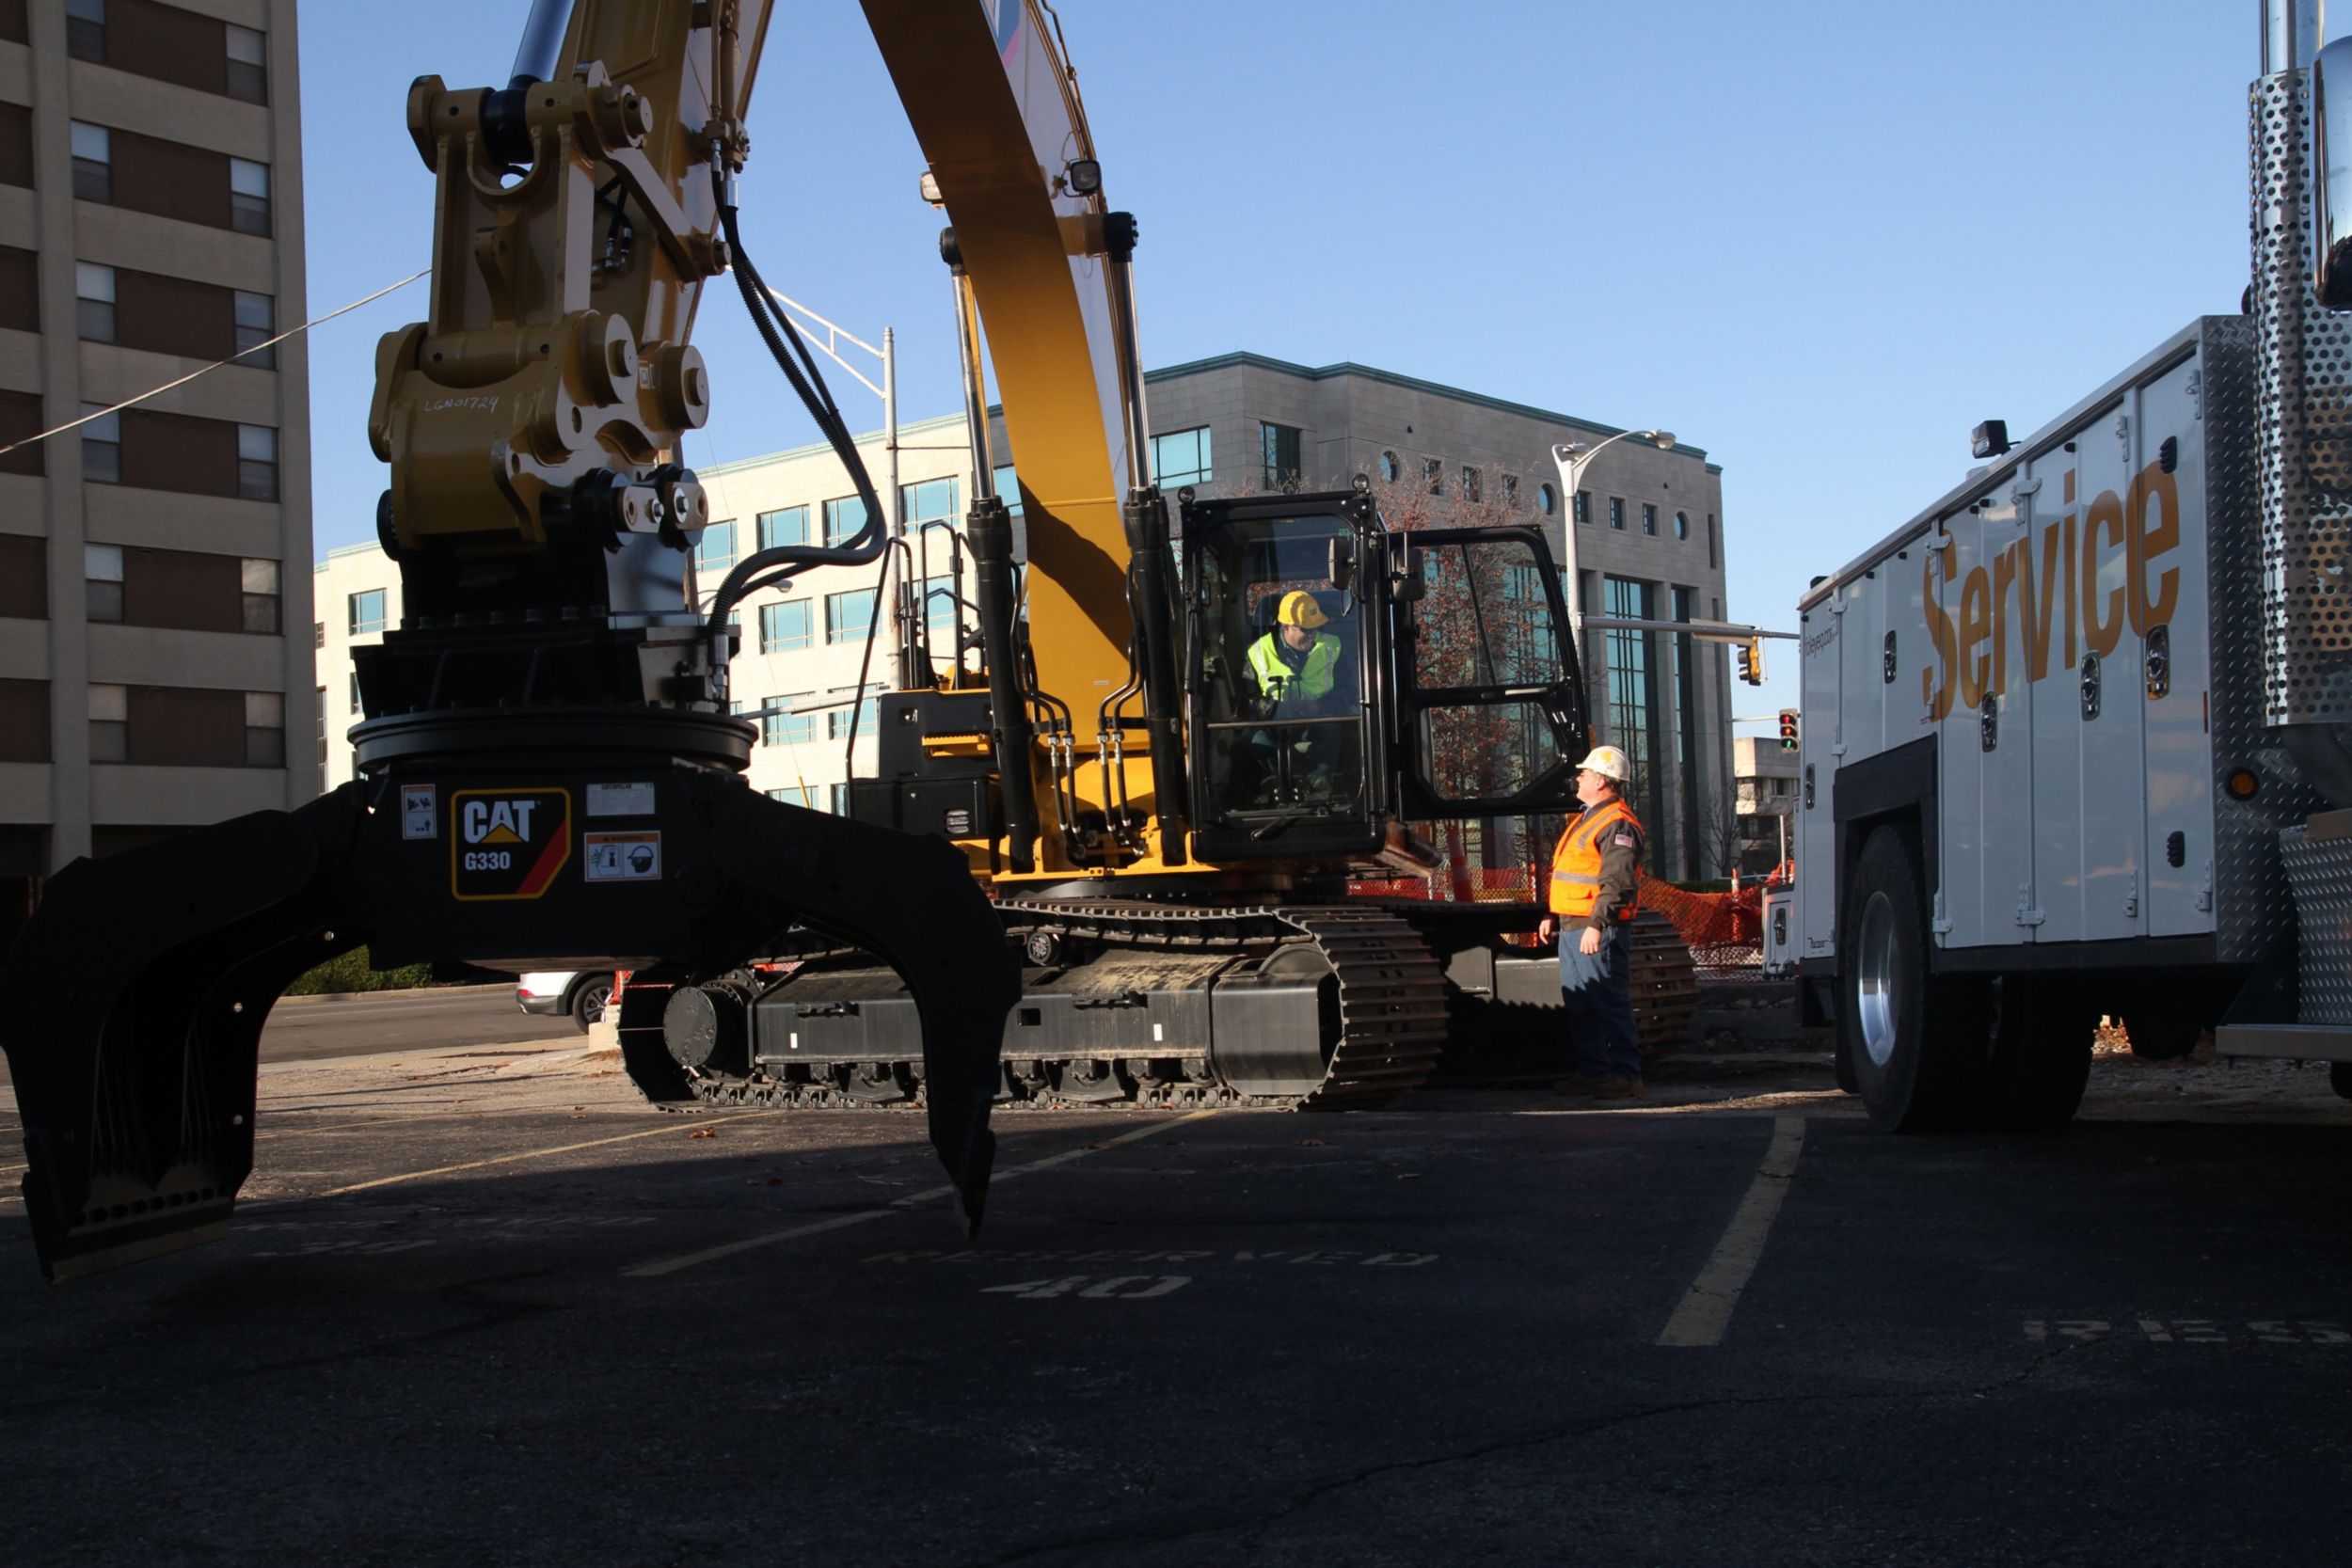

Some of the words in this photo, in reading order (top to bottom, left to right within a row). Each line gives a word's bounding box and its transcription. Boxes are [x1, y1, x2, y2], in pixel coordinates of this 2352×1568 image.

[1922, 460, 2181, 722] Service
[464, 800, 535, 845] CAT
[465, 851, 511, 871] G330
[855, 1249, 1440, 1266] RESERVED
[978, 1275, 1193, 1299] 40
